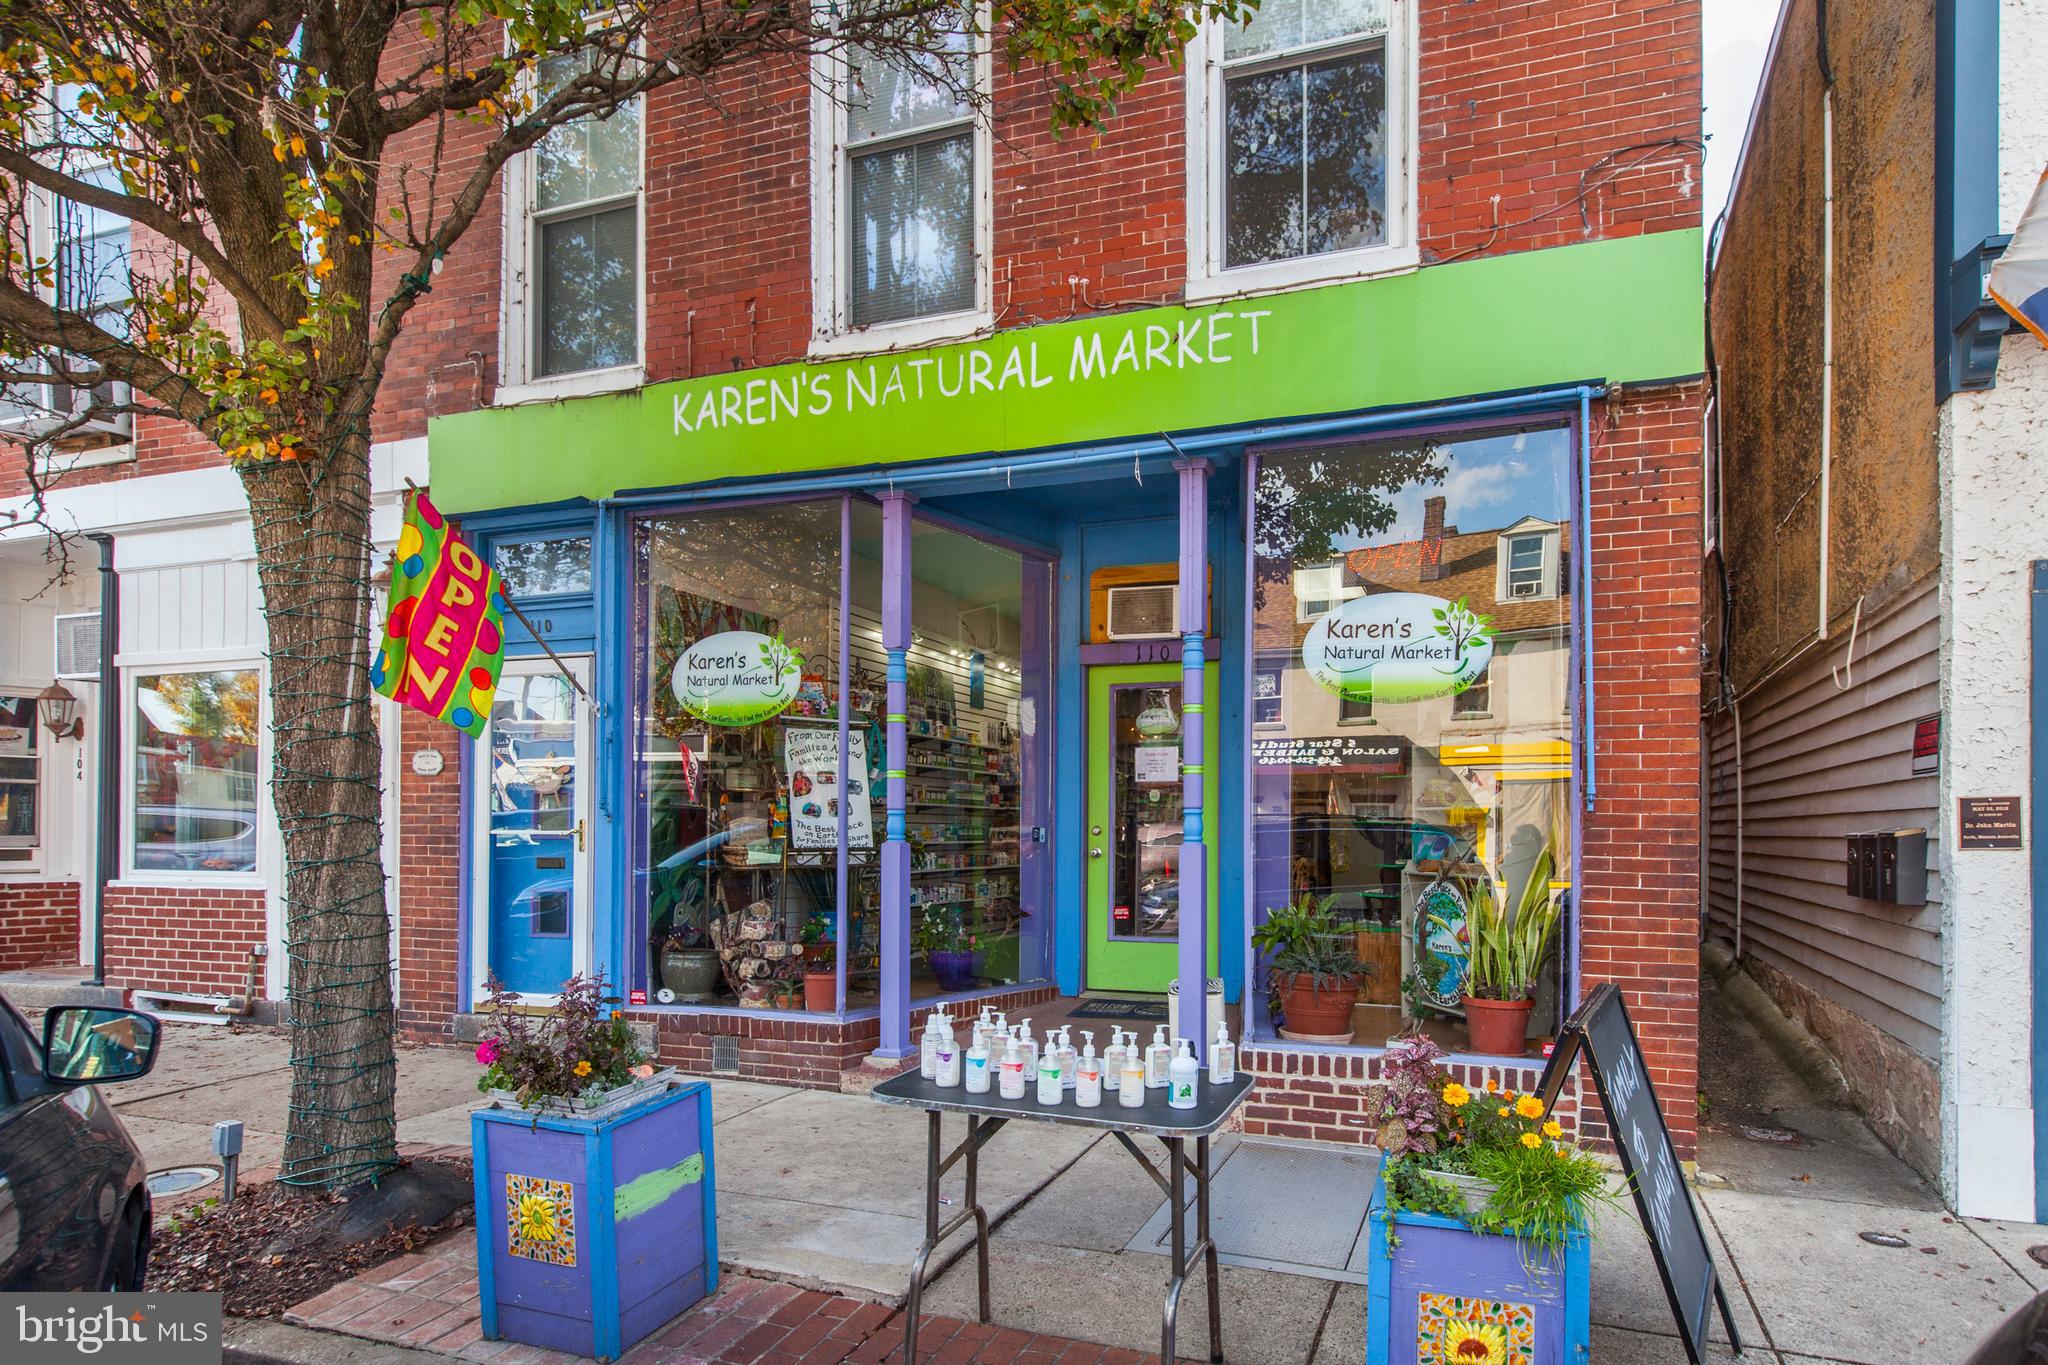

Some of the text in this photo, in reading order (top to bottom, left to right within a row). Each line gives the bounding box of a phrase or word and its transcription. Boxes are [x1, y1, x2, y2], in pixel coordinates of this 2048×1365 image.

[673, 310, 1272, 436] KAREN'S NATURAL MARKET
[1346, 538, 1444, 572] OPEN
[404, 541, 482, 705] OPEN
[1327, 617, 1412, 639] Karen's
[688, 651, 746, 670] Karen's
[1136, 644, 1170, 661] 110
[1324, 644, 1452, 660] Natural Market
[687, 673, 774, 687] Natural Market
[1315, 670, 1327, 683] The
[1327, 679, 1340, 692] Best
[1397, 697, 1406, 705] to
[1406, 696, 1421, 704] Find
[1422, 692, 1435, 702] the
[1461, 671, 1477, 684] Best
[787, 731, 862, 745] From Our Fily
[787, 744, 828, 761] Families
[813, 751, 838, 763] Worl
[796, 819, 812, 831] The
[814, 825, 836, 833] Best
[816, 831, 838, 839] Eart
